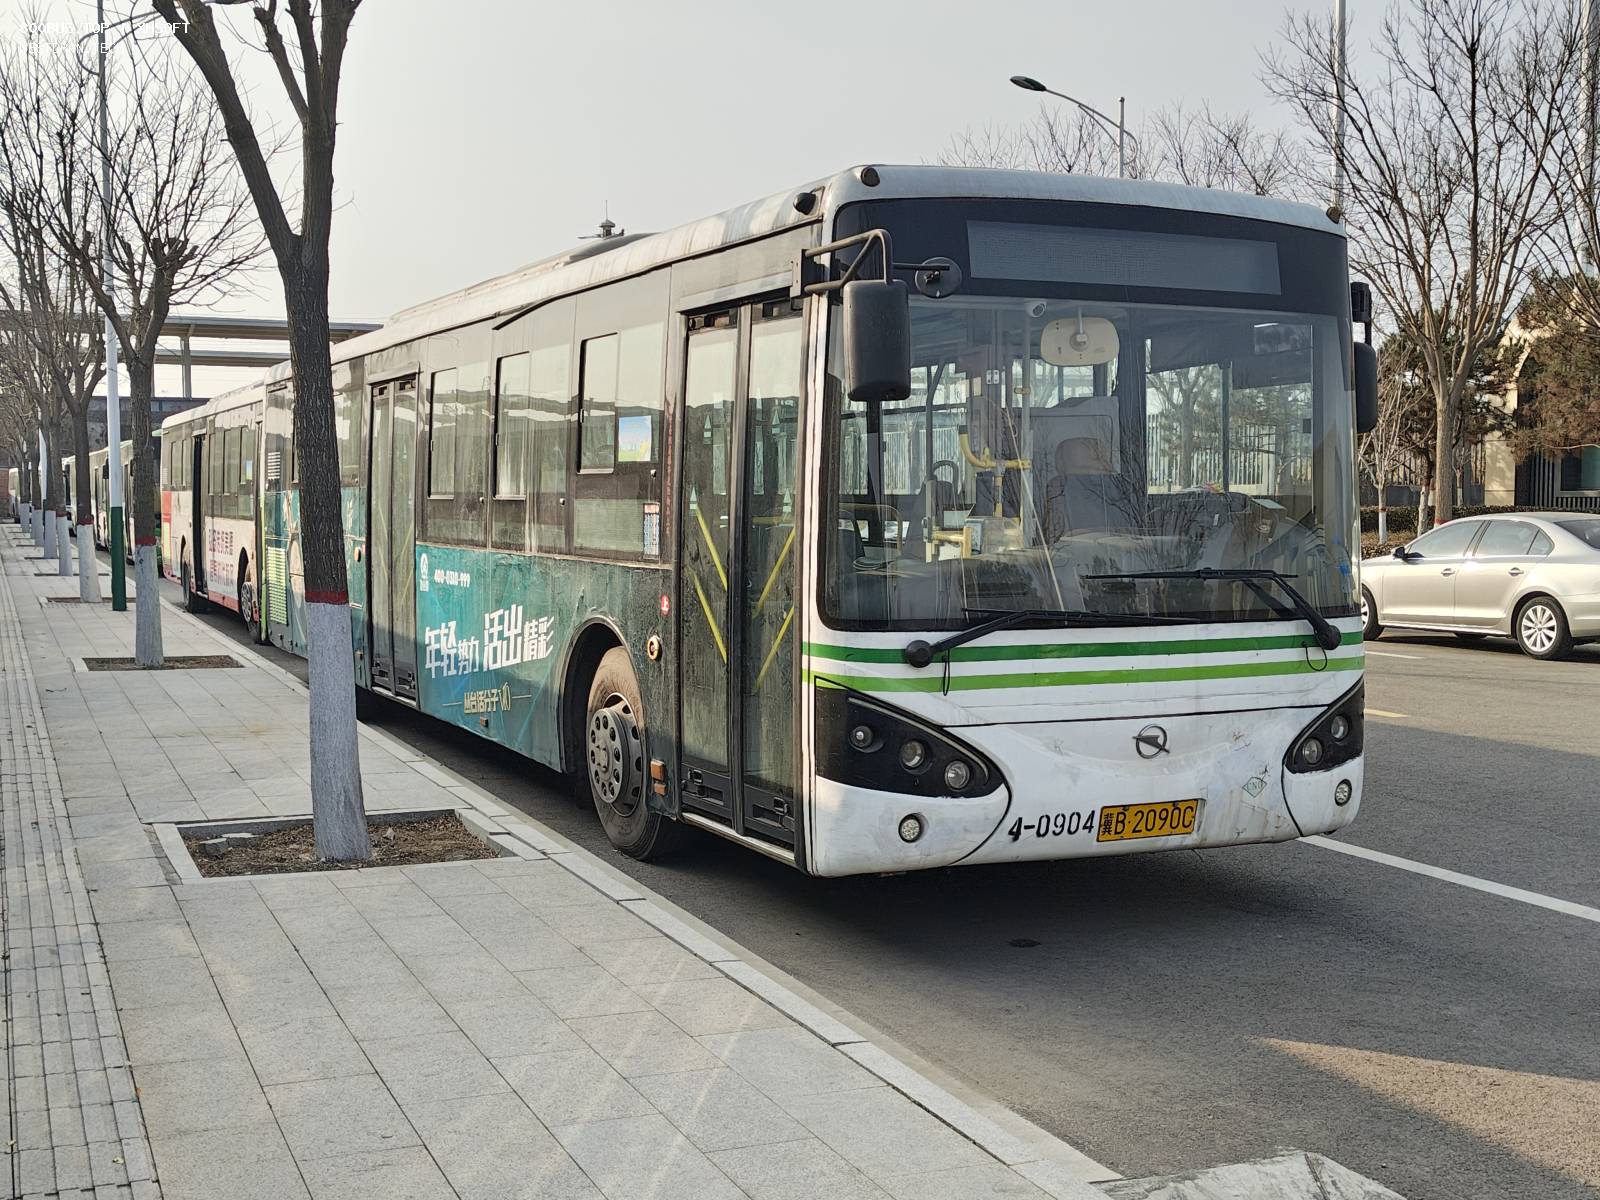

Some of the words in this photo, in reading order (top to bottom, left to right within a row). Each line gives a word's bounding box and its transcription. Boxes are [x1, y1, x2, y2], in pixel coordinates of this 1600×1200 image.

[424, 620, 479, 680] 年轻势力
[482, 603, 555, 673] 活出精彩
[1008, 809, 1096, 842] 4-0904
